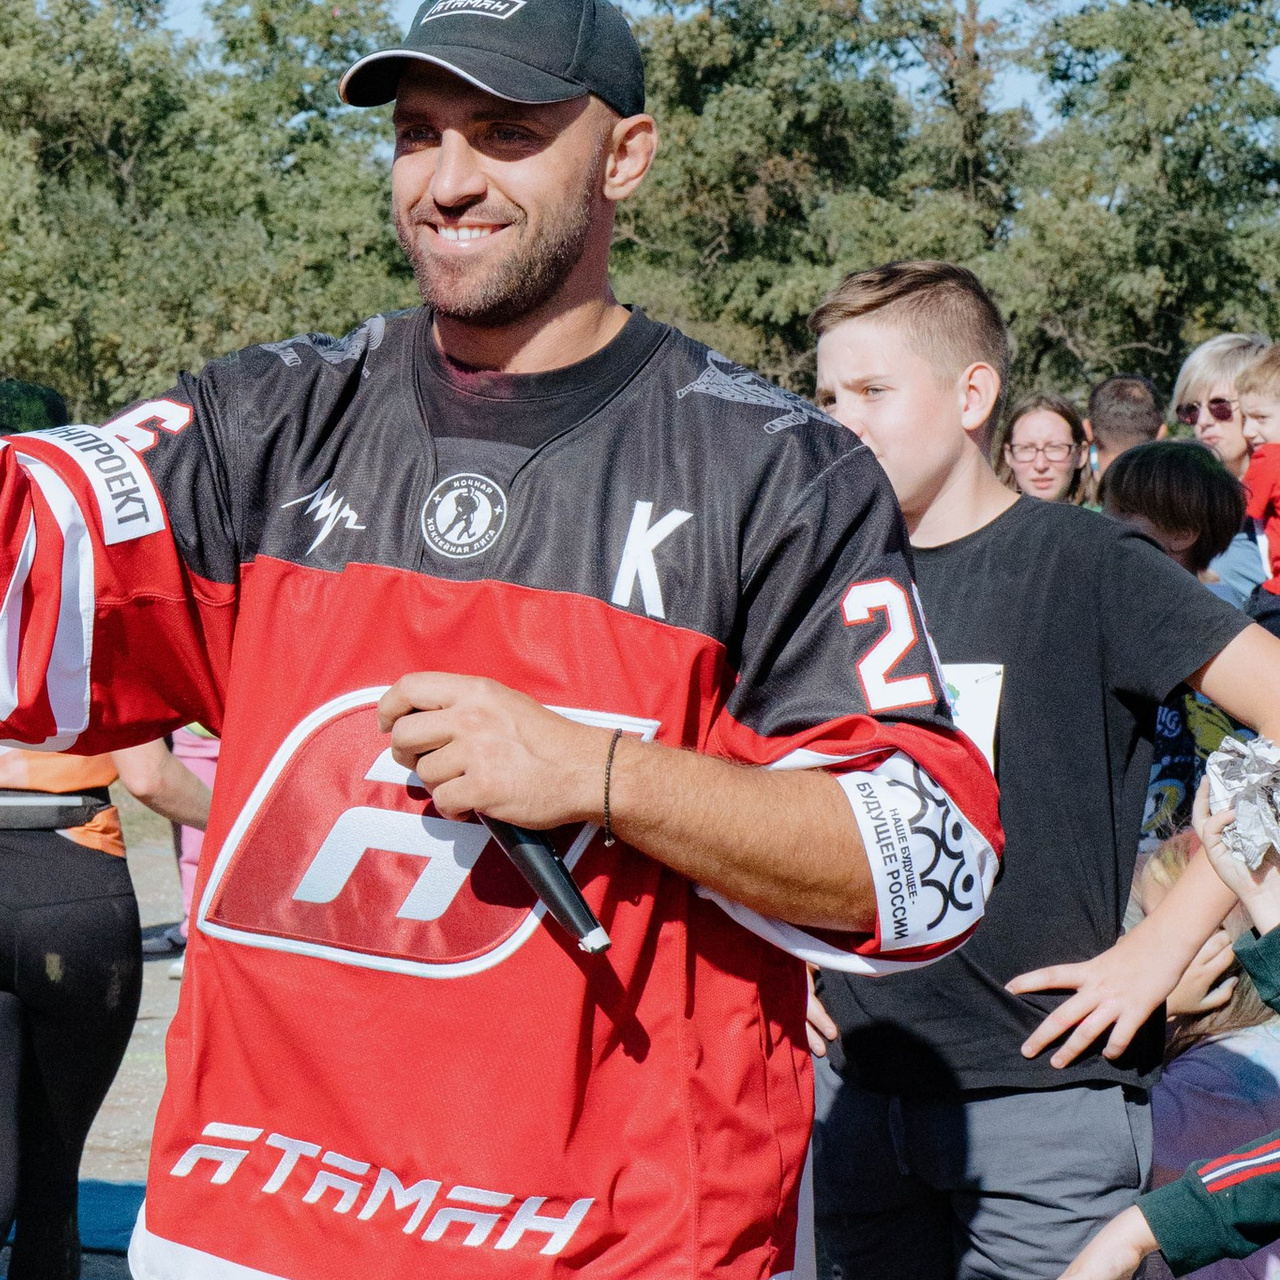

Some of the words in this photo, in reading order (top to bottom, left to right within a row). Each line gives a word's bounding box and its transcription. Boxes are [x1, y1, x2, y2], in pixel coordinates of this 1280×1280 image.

[453, 479, 494, 495] НОЧНАЯ
[473, 529, 496, 550] ЛИГА
[840, 576, 950, 714] 2
[856, 782, 898, 867] БУДУЩЕЕ
[886, 868, 909, 940] РОССИИ
[889, 808, 908, 845] НАШЕ
[900, 845, 918, 899] БУДУЩЕЕ
